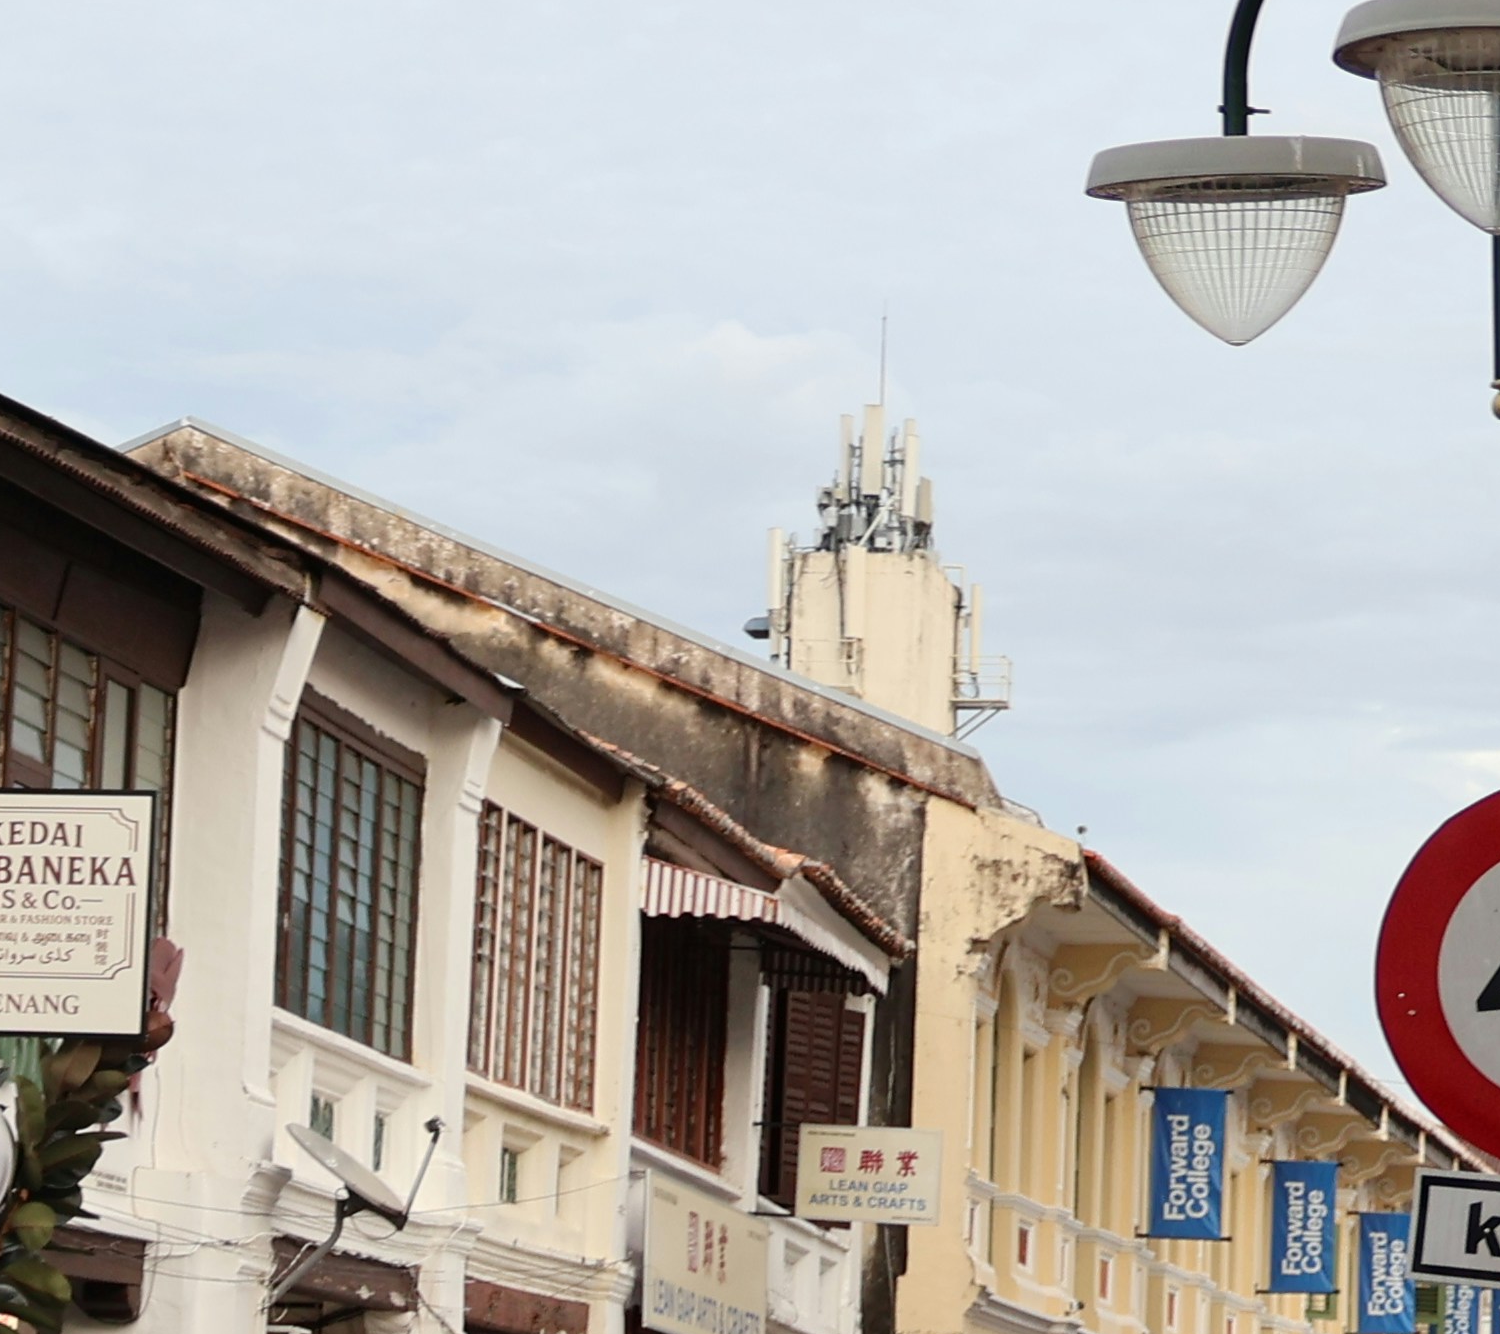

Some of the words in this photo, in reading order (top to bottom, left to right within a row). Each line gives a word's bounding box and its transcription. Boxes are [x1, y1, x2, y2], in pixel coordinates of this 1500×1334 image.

[10, 915, 17, 924] &
[19, 914, 72, 925] FASHION
[74, 916, 114, 926] STORE
[21, 892, 37, 909] &
[43, 890, 81, 910] Co.
[809, 1193, 848, 1206] ARTS
[853, 1196, 862, 1208] &
[867, 1196, 927, 1212] CRAFTS
[829, 1179, 868, 1192] LEAN
[873, 1181, 908, 1195] GIAP
[1163, 1115, 1190, 1221] Forward
[1185, 1123, 1215, 1218] College
[1281, 1181, 1305, 1275] Forward
[1301, 1190, 1328, 1274] College
[653, 1279, 674, 1315] LEAN
[676, 1286, 695, 1325] GIAP
[697, 1295, 717, 1334] ARTS
[1367, 1232, 1388, 1316] Forward
[1385, 1239, 1406, 1315] College
